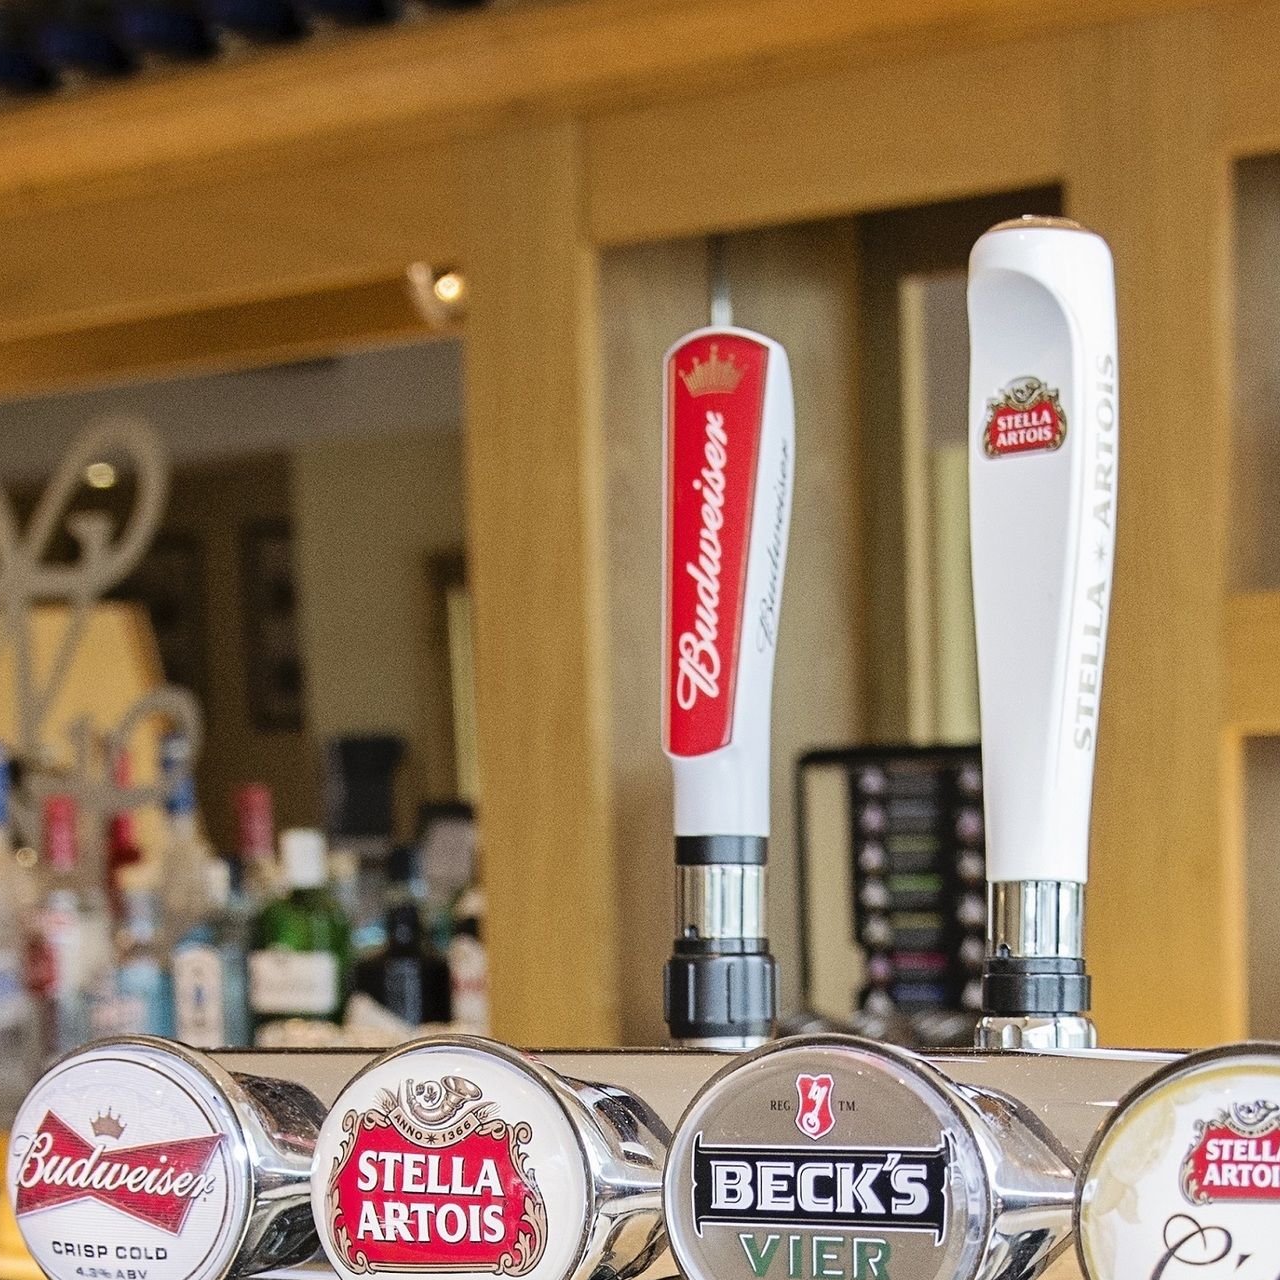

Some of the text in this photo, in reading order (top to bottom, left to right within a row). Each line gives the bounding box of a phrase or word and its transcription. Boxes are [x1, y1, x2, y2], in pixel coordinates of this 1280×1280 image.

[996, 425, 1053, 447] ARTOIS
[997, 410, 1052, 432] STELLA
[677, 409, 728, 710] Budweiser
[1073, 353, 1114, 752] STELLA ARTOIS
[394, 1113, 472, 1143] ANNO 1366
[14, 1131, 216, 1198] Budweiser
[357, 1150, 505, 1197] STELLA
[710, 1153, 930, 1215] BECK'S
[357, 1200, 506, 1243] ARTOIS
[52, 1240, 168, 1261] CRISP COLD
[116, 1269, 147, 1280] ABV
